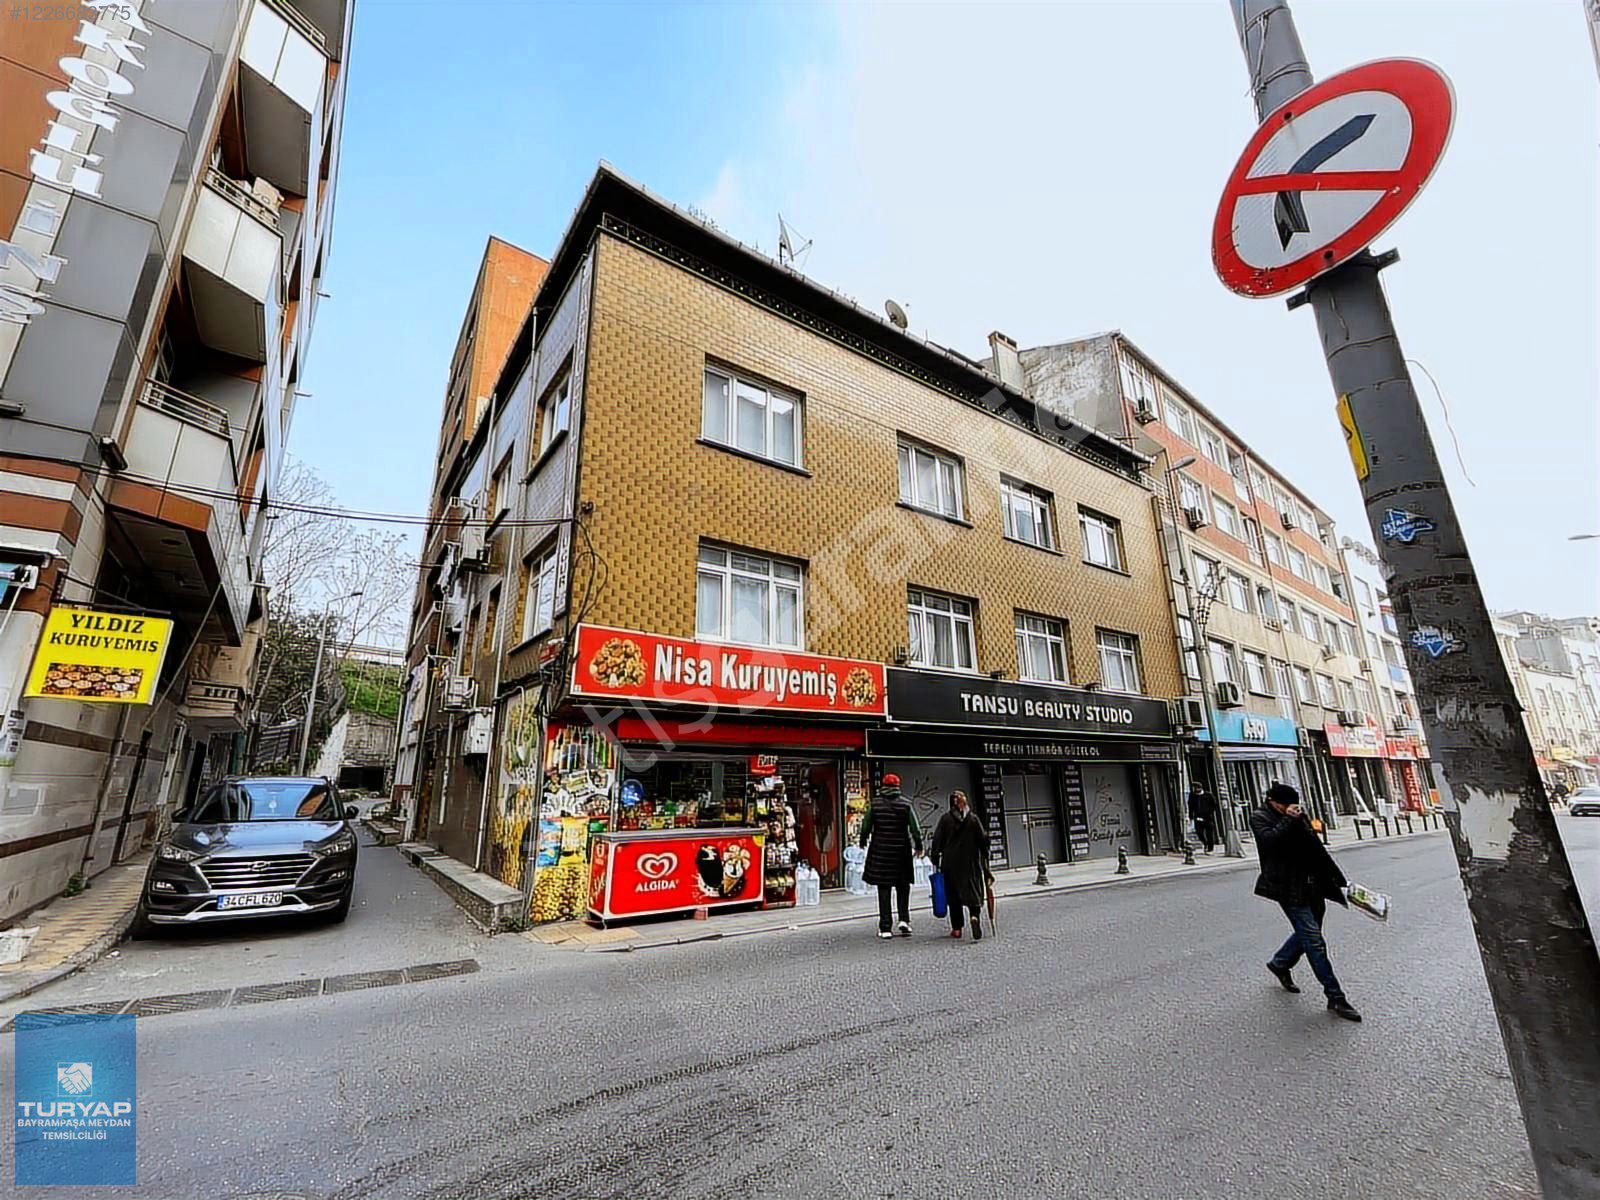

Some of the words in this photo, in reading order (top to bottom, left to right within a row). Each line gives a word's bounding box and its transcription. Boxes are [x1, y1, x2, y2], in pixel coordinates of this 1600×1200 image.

[71, 614, 146, 635] YILDIZ
[49, 632, 159, 653] KURUYEMIS
[654, 643, 713, 687] Nisa
[720, 652, 838, 706] Kuruyemiş
[960, 693, 1019, 715] TANSU
[1025, 699, 1081, 721] BEAUTY
[1085, 705, 1134, 725] STUDIO
[635, 880, 677, 893] ALGIDA
